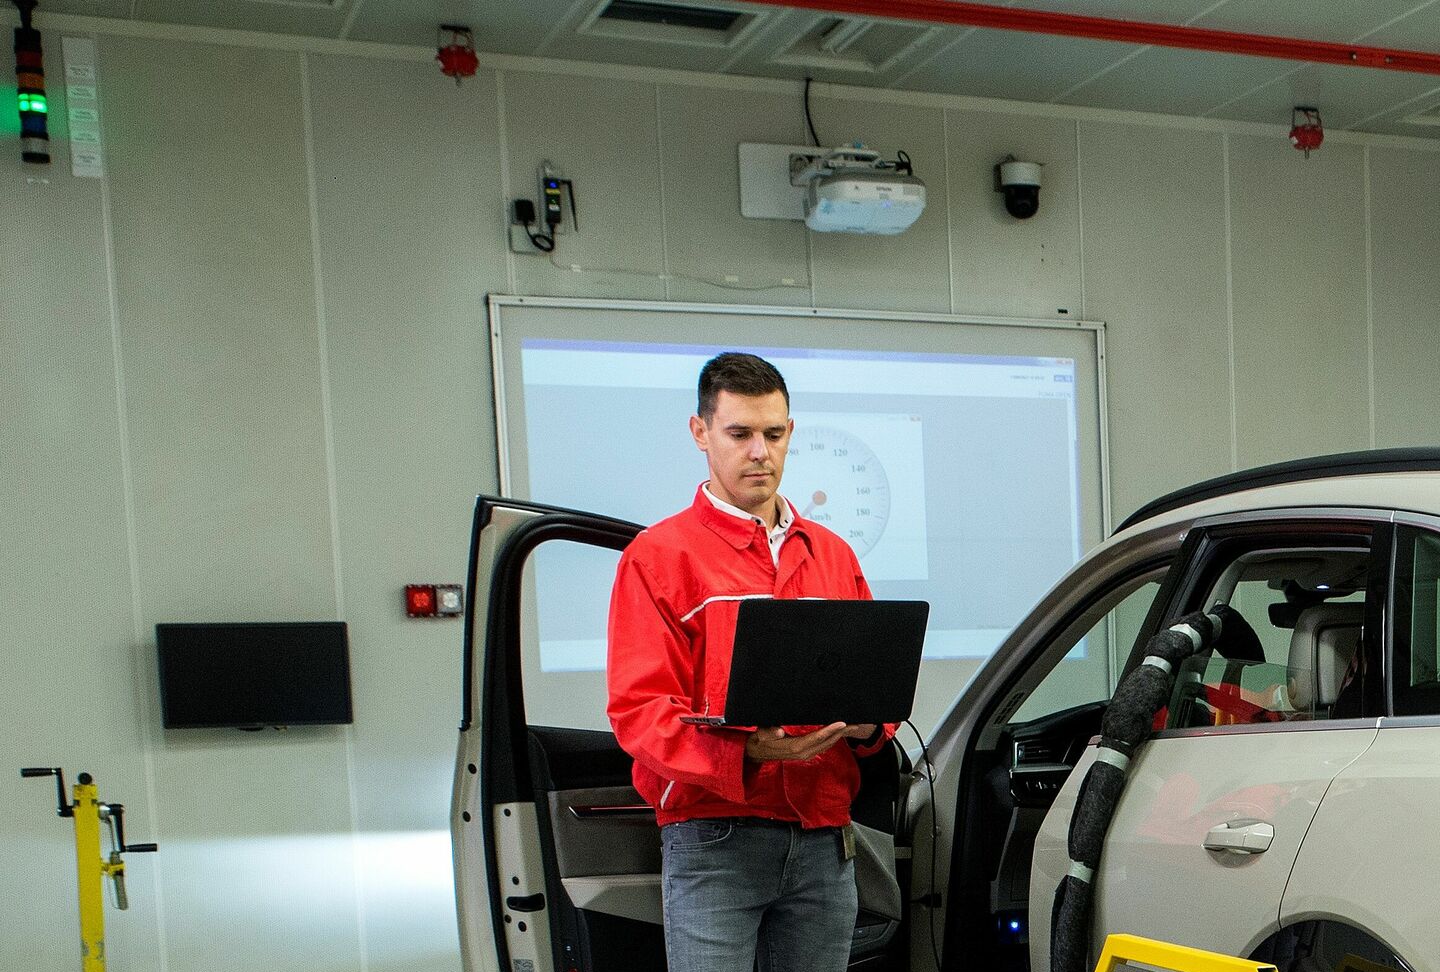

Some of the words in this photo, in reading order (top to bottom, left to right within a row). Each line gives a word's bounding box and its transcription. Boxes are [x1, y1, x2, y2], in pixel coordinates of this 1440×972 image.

[810, 443, 825, 451] 100
[833, 449, 848, 457] 120
[851, 465, 866, 473] 140
[856, 487, 871, 495] 160
[856, 508, 871, 516] 180
[849, 530, 864, 538] 200
